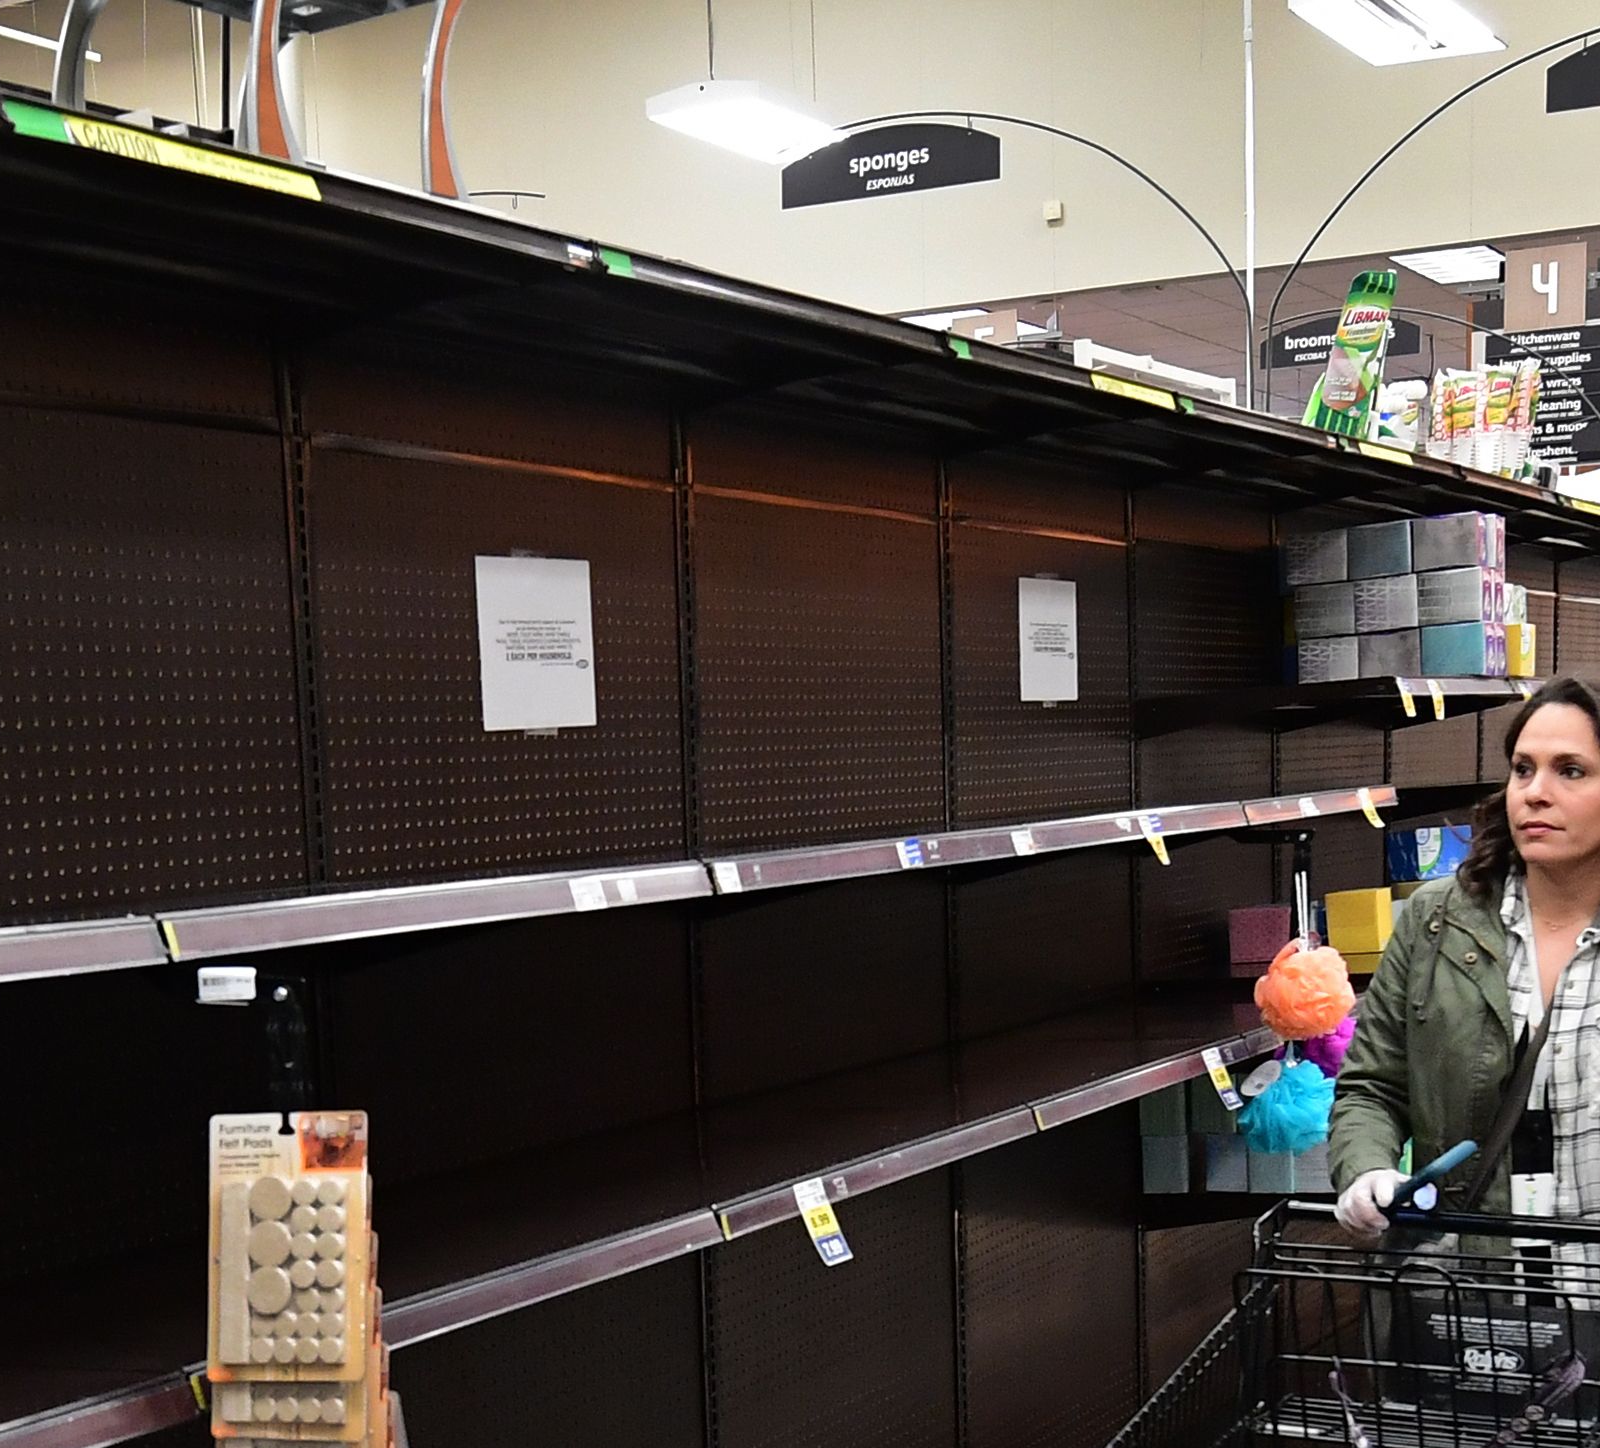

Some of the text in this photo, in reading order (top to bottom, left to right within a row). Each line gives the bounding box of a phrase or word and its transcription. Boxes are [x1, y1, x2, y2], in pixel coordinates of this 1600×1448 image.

[849, 147, 930, 177] sponges
[866, 173, 914, 190] ESPONJAS
[1532, 261, 1559, 314] 4
[1343, 310, 1388, 327] LIBMAN
[1510, 331, 1581, 345] kitchenware
[1544, 352, 1591, 367] supplies
[243, 1138, 272, 1149] Pads
